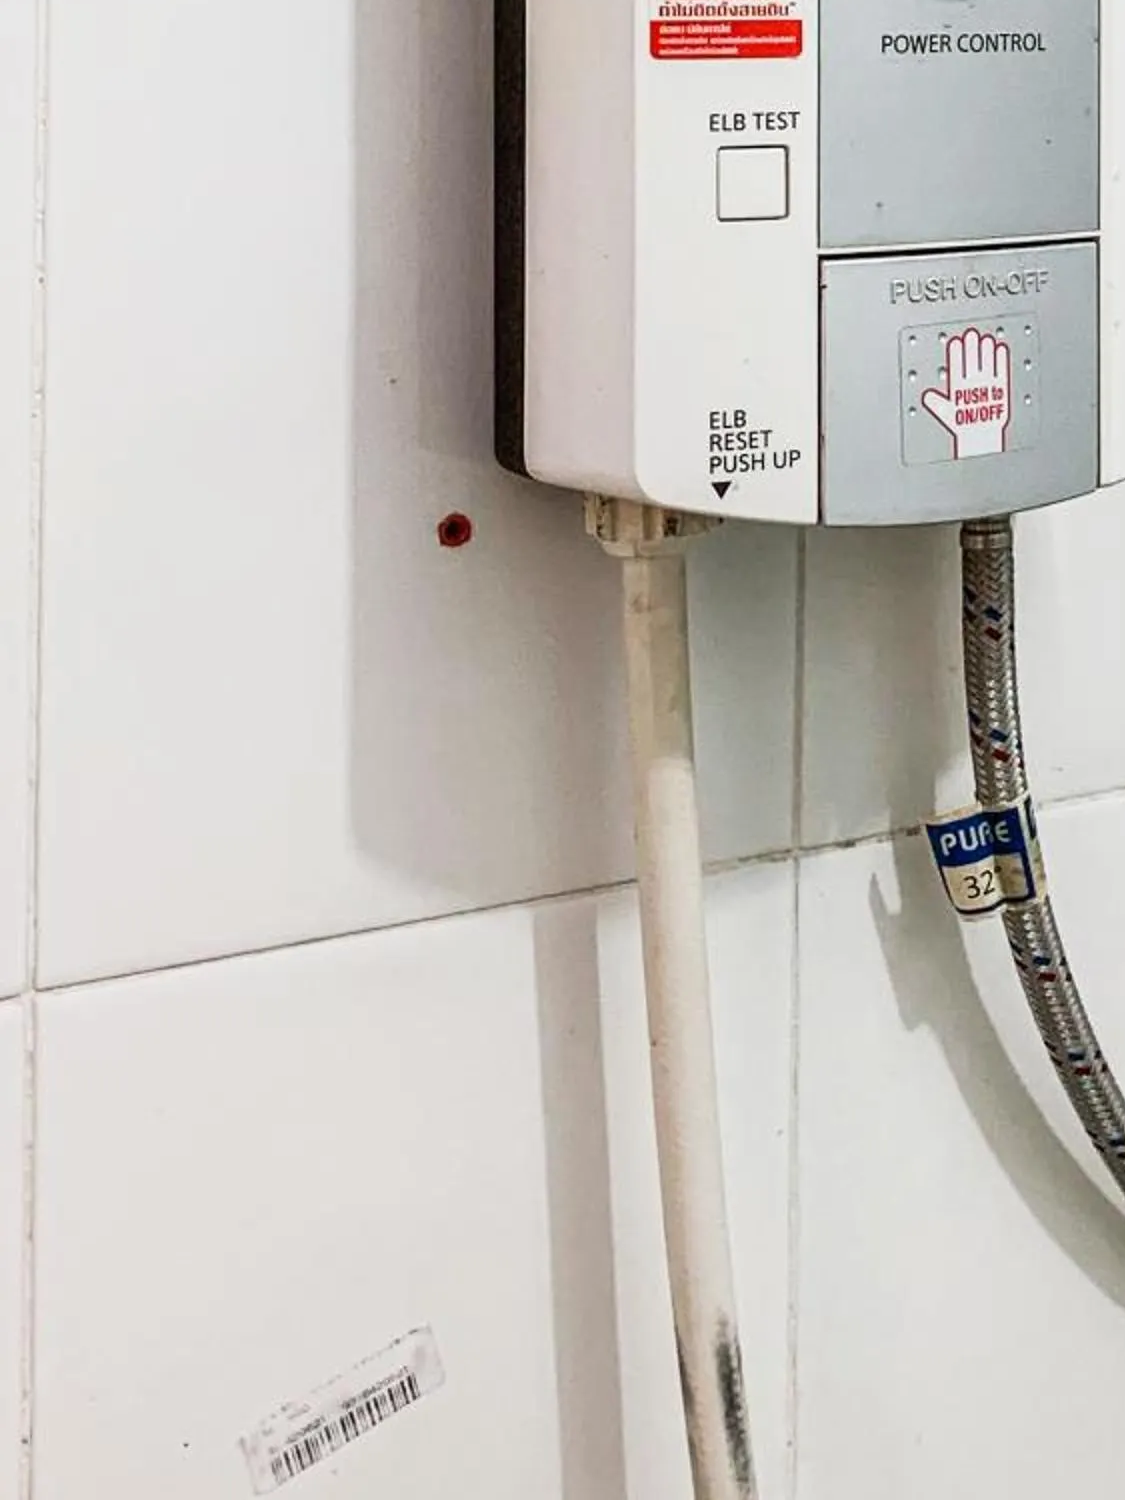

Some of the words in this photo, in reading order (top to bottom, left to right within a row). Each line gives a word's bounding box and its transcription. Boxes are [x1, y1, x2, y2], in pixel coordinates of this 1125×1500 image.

[881, 35, 952, 54] POWER
[957, 33, 1046, 53] CONTROL
[709, 113, 746, 132] ELB
[752, 111, 800, 131] TEST
[890, 277, 957, 305] PUSH
[963, 270, 1049, 299] ON-OFF
[954, 387, 988, 406] PUSH
[991, 386, 1004, 401] to
[709, 411, 746, 430] ELB
[955, 404, 1005, 426] ON/OFF
[709, 430, 772, 452] RESET
[709, 454, 765, 474] PUSH
[772, 450, 801, 471] UP
[940, 820, 1012, 856] PURE
